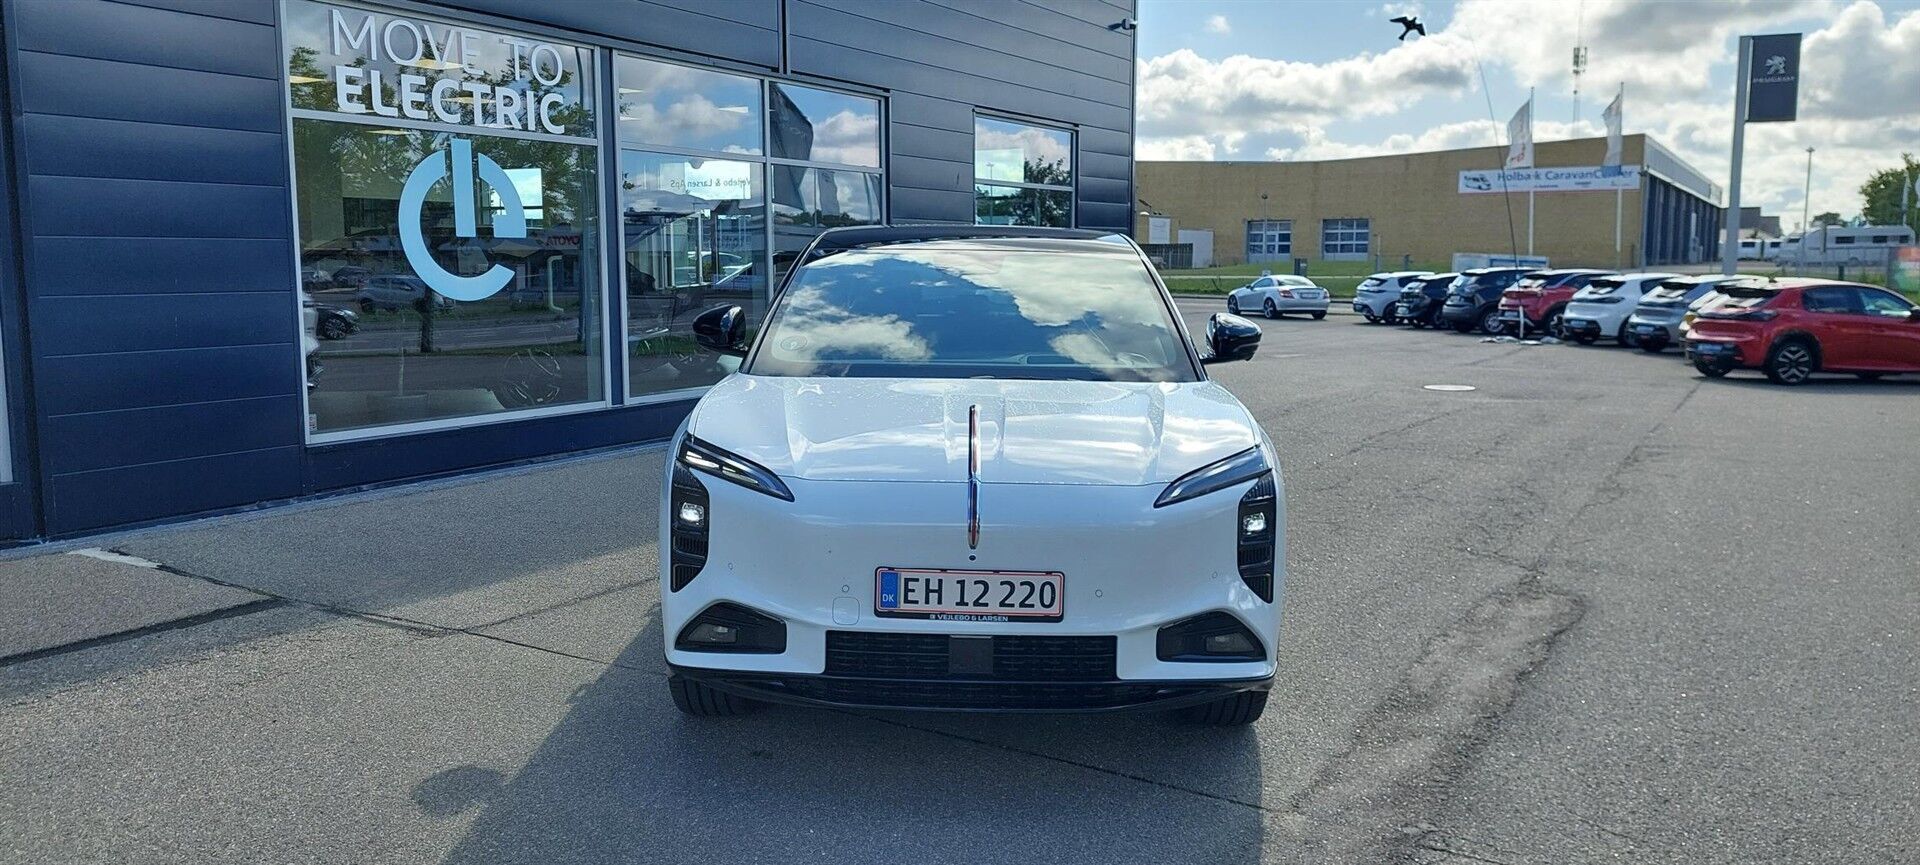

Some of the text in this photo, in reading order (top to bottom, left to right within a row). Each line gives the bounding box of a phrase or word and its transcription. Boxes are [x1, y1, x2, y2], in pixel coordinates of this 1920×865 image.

[331, 9, 564, 86] MOVE TO
[334, 65, 565, 135] ELECTRIC
[882, 594, 895, 603] DK
[903, 577, 1057, 609] EH 12 220
[937, 613, 970, 621] VEJLEBO
